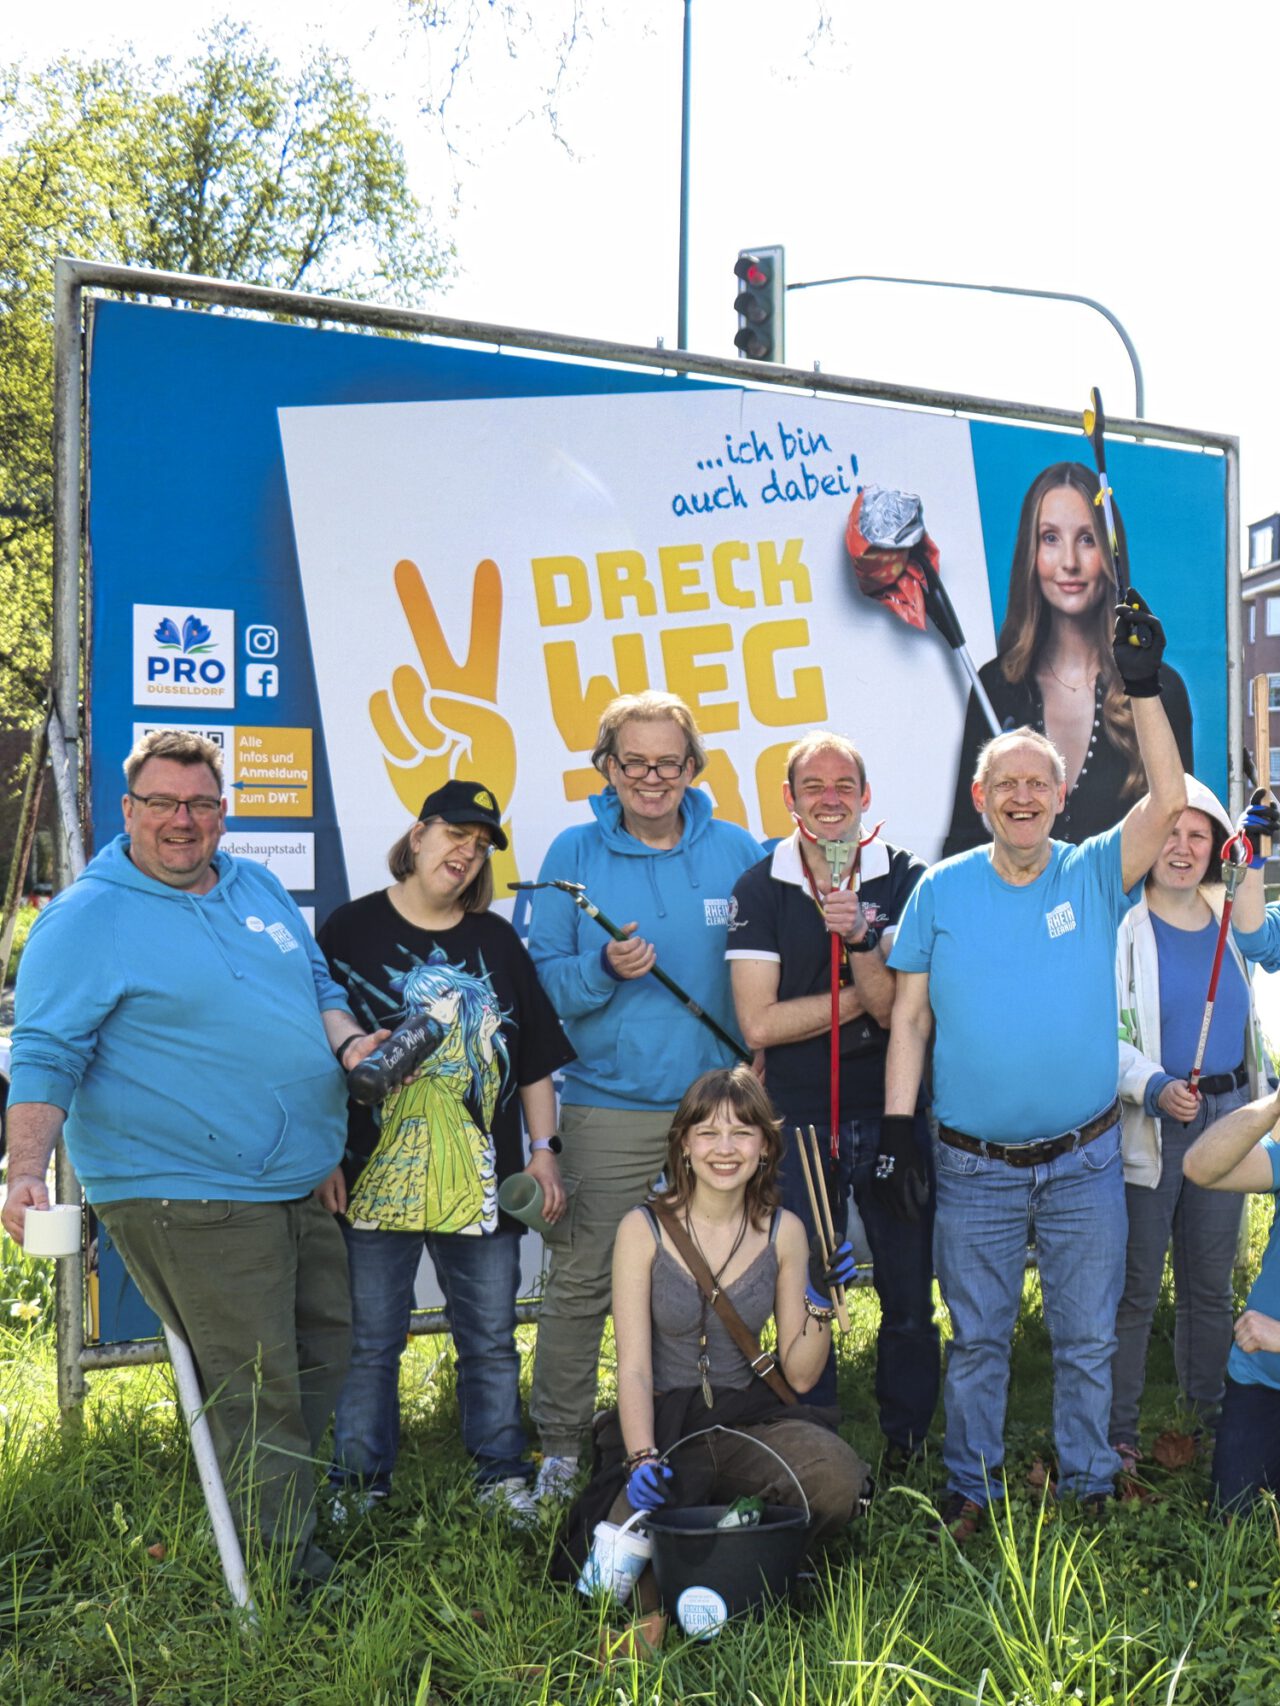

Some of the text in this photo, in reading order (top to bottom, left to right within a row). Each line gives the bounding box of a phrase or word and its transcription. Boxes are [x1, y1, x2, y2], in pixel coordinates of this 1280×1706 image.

[777, 421, 833, 461] bin
[672, 453, 863, 517] auch dabei!
[531, 538, 813, 627] DRECK
[147, 656, 226, 684] PRO
[147, 683, 225, 696] DÜSSELDORF
[543, 618, 828, 752] WEG
[239, 735, 263, 748] Alle
[239, 751, 295, 763] Infos und
[239, 766, 309, 781] Anmeldung
[240, 792, 300, 804] zum DWT.
[220, 842, 307, 857] ndeshauptstadt
